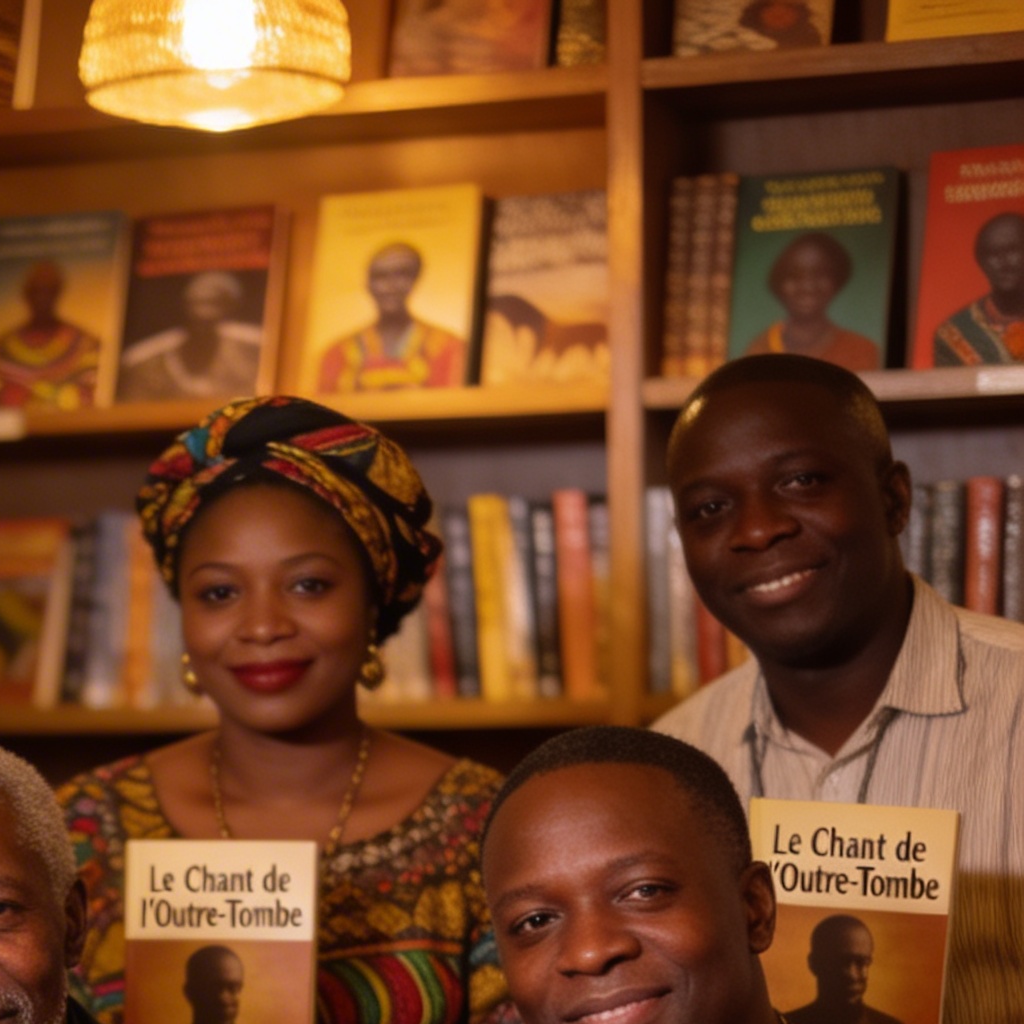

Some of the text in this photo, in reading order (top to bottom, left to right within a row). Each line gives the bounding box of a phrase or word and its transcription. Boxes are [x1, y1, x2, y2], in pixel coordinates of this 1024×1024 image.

[773, 824, 926, 862] Le Chant de
[150, 863, 291, 893] Le Chant de
[769, 860, 939, 900] 'Outre-Tombe
[141, 898, 302, 928] l'Outre-Tombe
